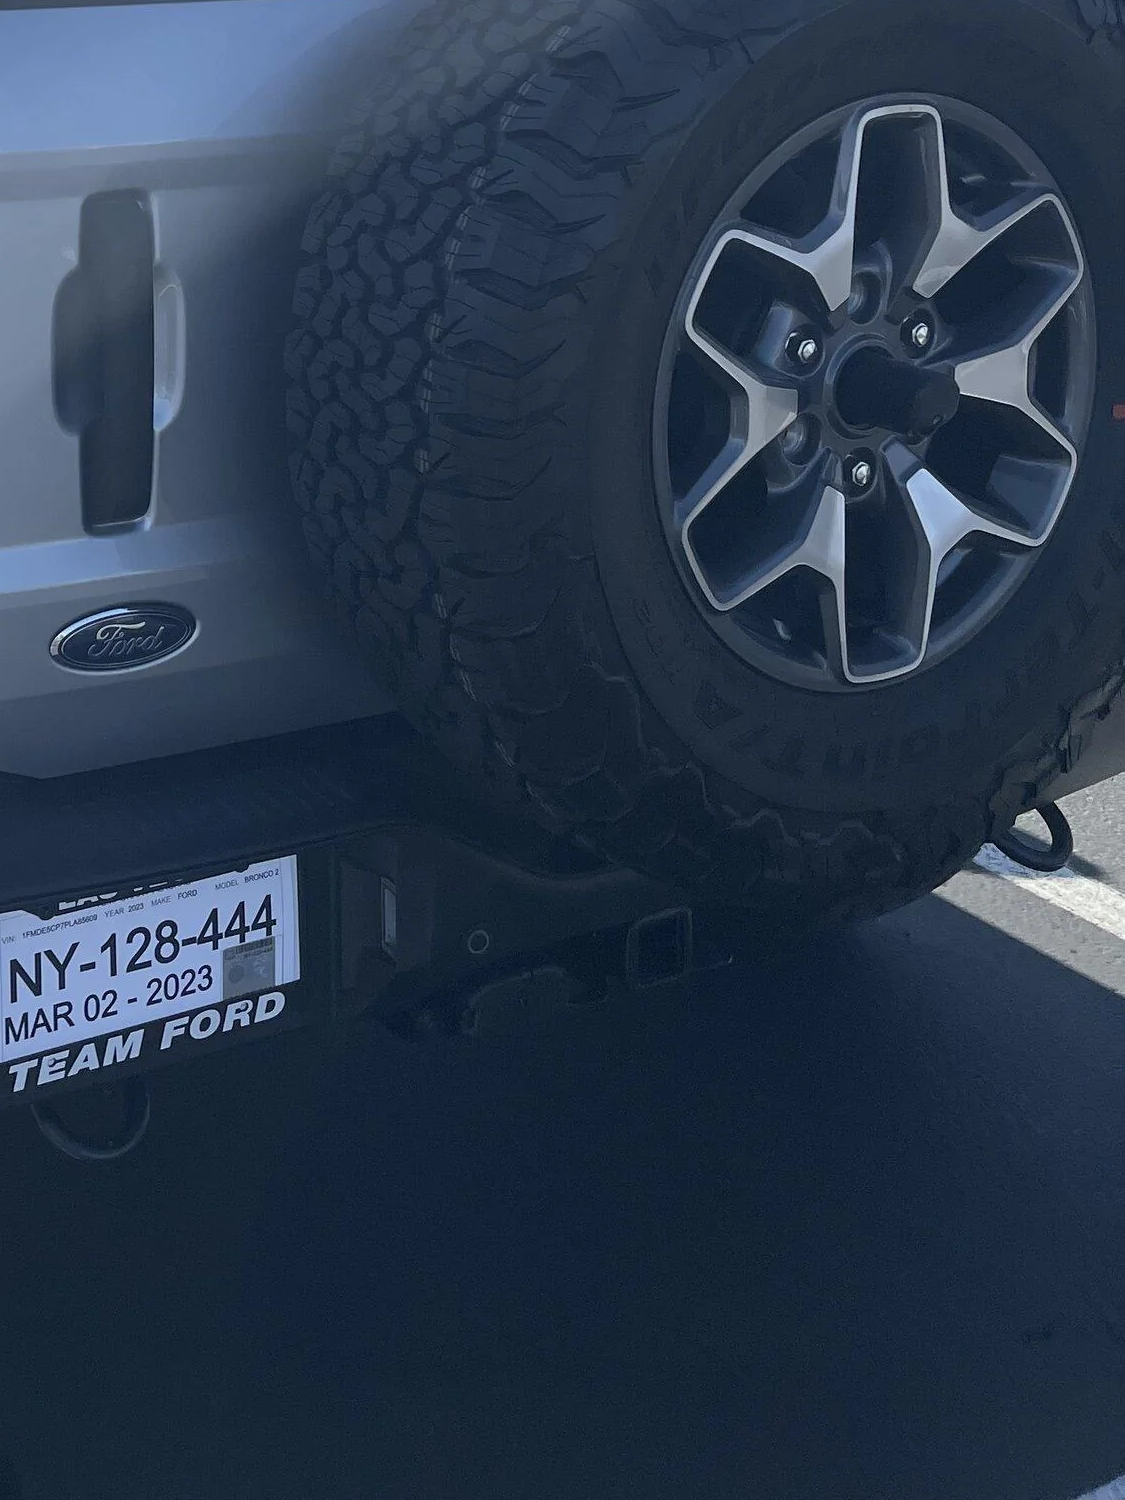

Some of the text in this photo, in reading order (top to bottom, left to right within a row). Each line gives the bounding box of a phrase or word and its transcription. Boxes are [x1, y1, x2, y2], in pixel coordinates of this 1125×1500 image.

[87, 621, 165, 657] Ford
[104, 907, 125, 918] YEAR
[128, 903, 145, 913] 2023
[151, 896, 171, 906] MAKE
[177, 889, 198, 900] FORD
[215, 880, 239, 891] MODEL
[244, 871, 274, 884] BRONCO
[10, 894, 277, 1003] NY-128-444
[5, 1000, 75, 1045] MAR
[83, 989, 118, 1021] 02
[146, 964, 213, 1006] 2023
[8, 991, 287, 1093] TEAM FORD
